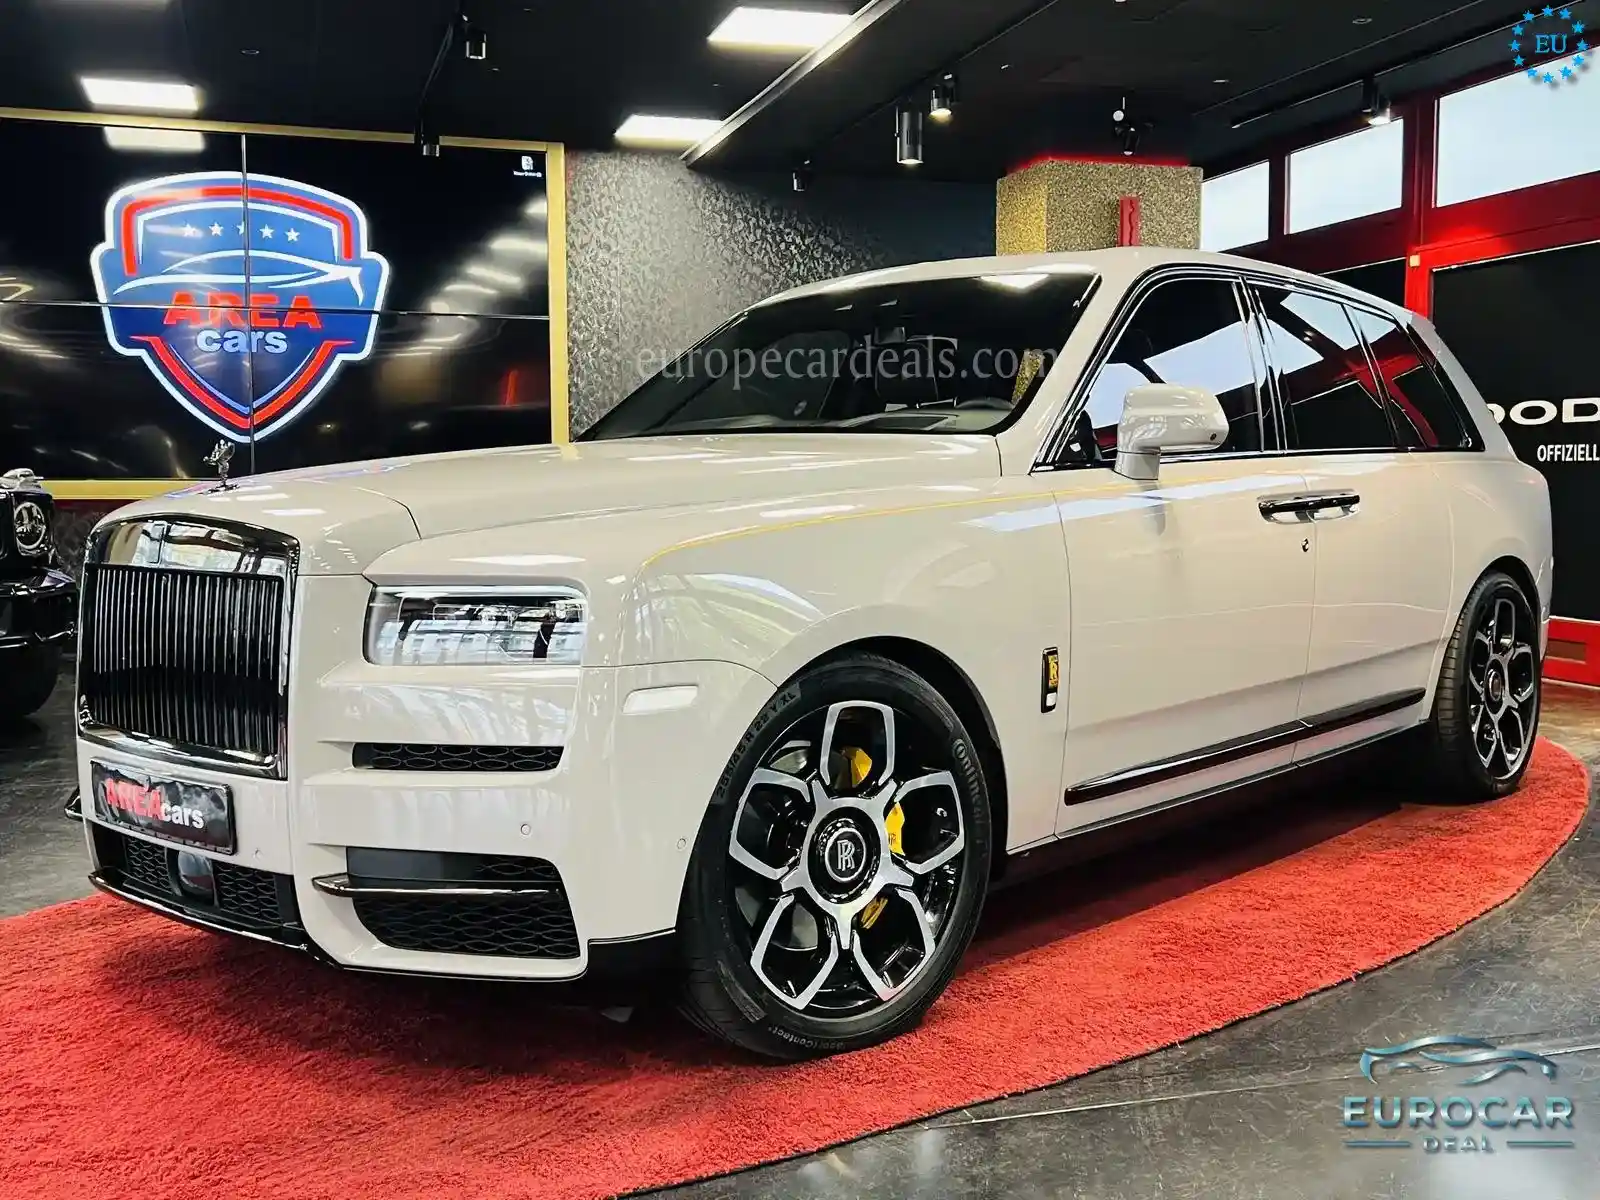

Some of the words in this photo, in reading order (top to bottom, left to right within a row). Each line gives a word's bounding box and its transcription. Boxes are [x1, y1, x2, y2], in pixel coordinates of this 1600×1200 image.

[163, 290, 323, 329] AREA
[197, 328, 288, 354] cars
[1536, 443, 1600, 462] OFFIZIELL
